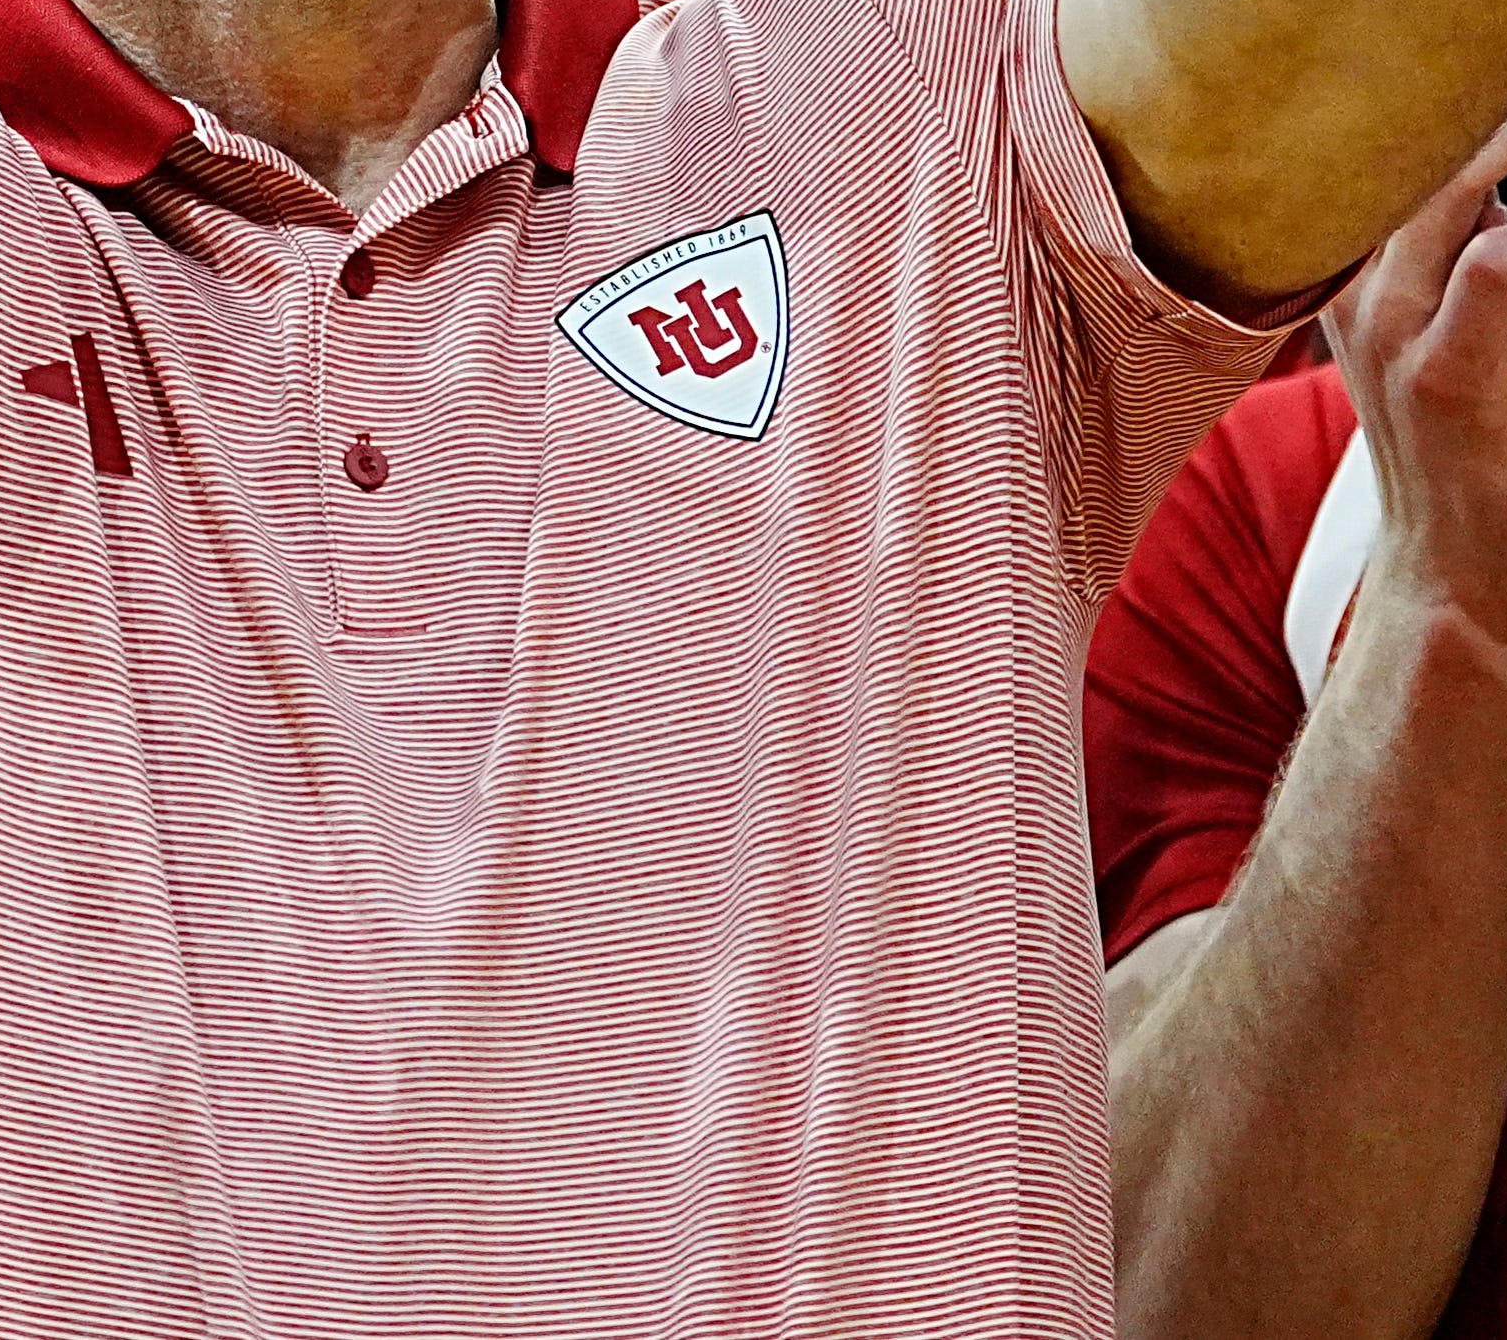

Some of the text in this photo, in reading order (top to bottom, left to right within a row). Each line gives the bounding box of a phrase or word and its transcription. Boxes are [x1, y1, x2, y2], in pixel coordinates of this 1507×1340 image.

[579, 223, 747, 313] ESTABLISHED 1869
[626, 277, 760, 381] NU
